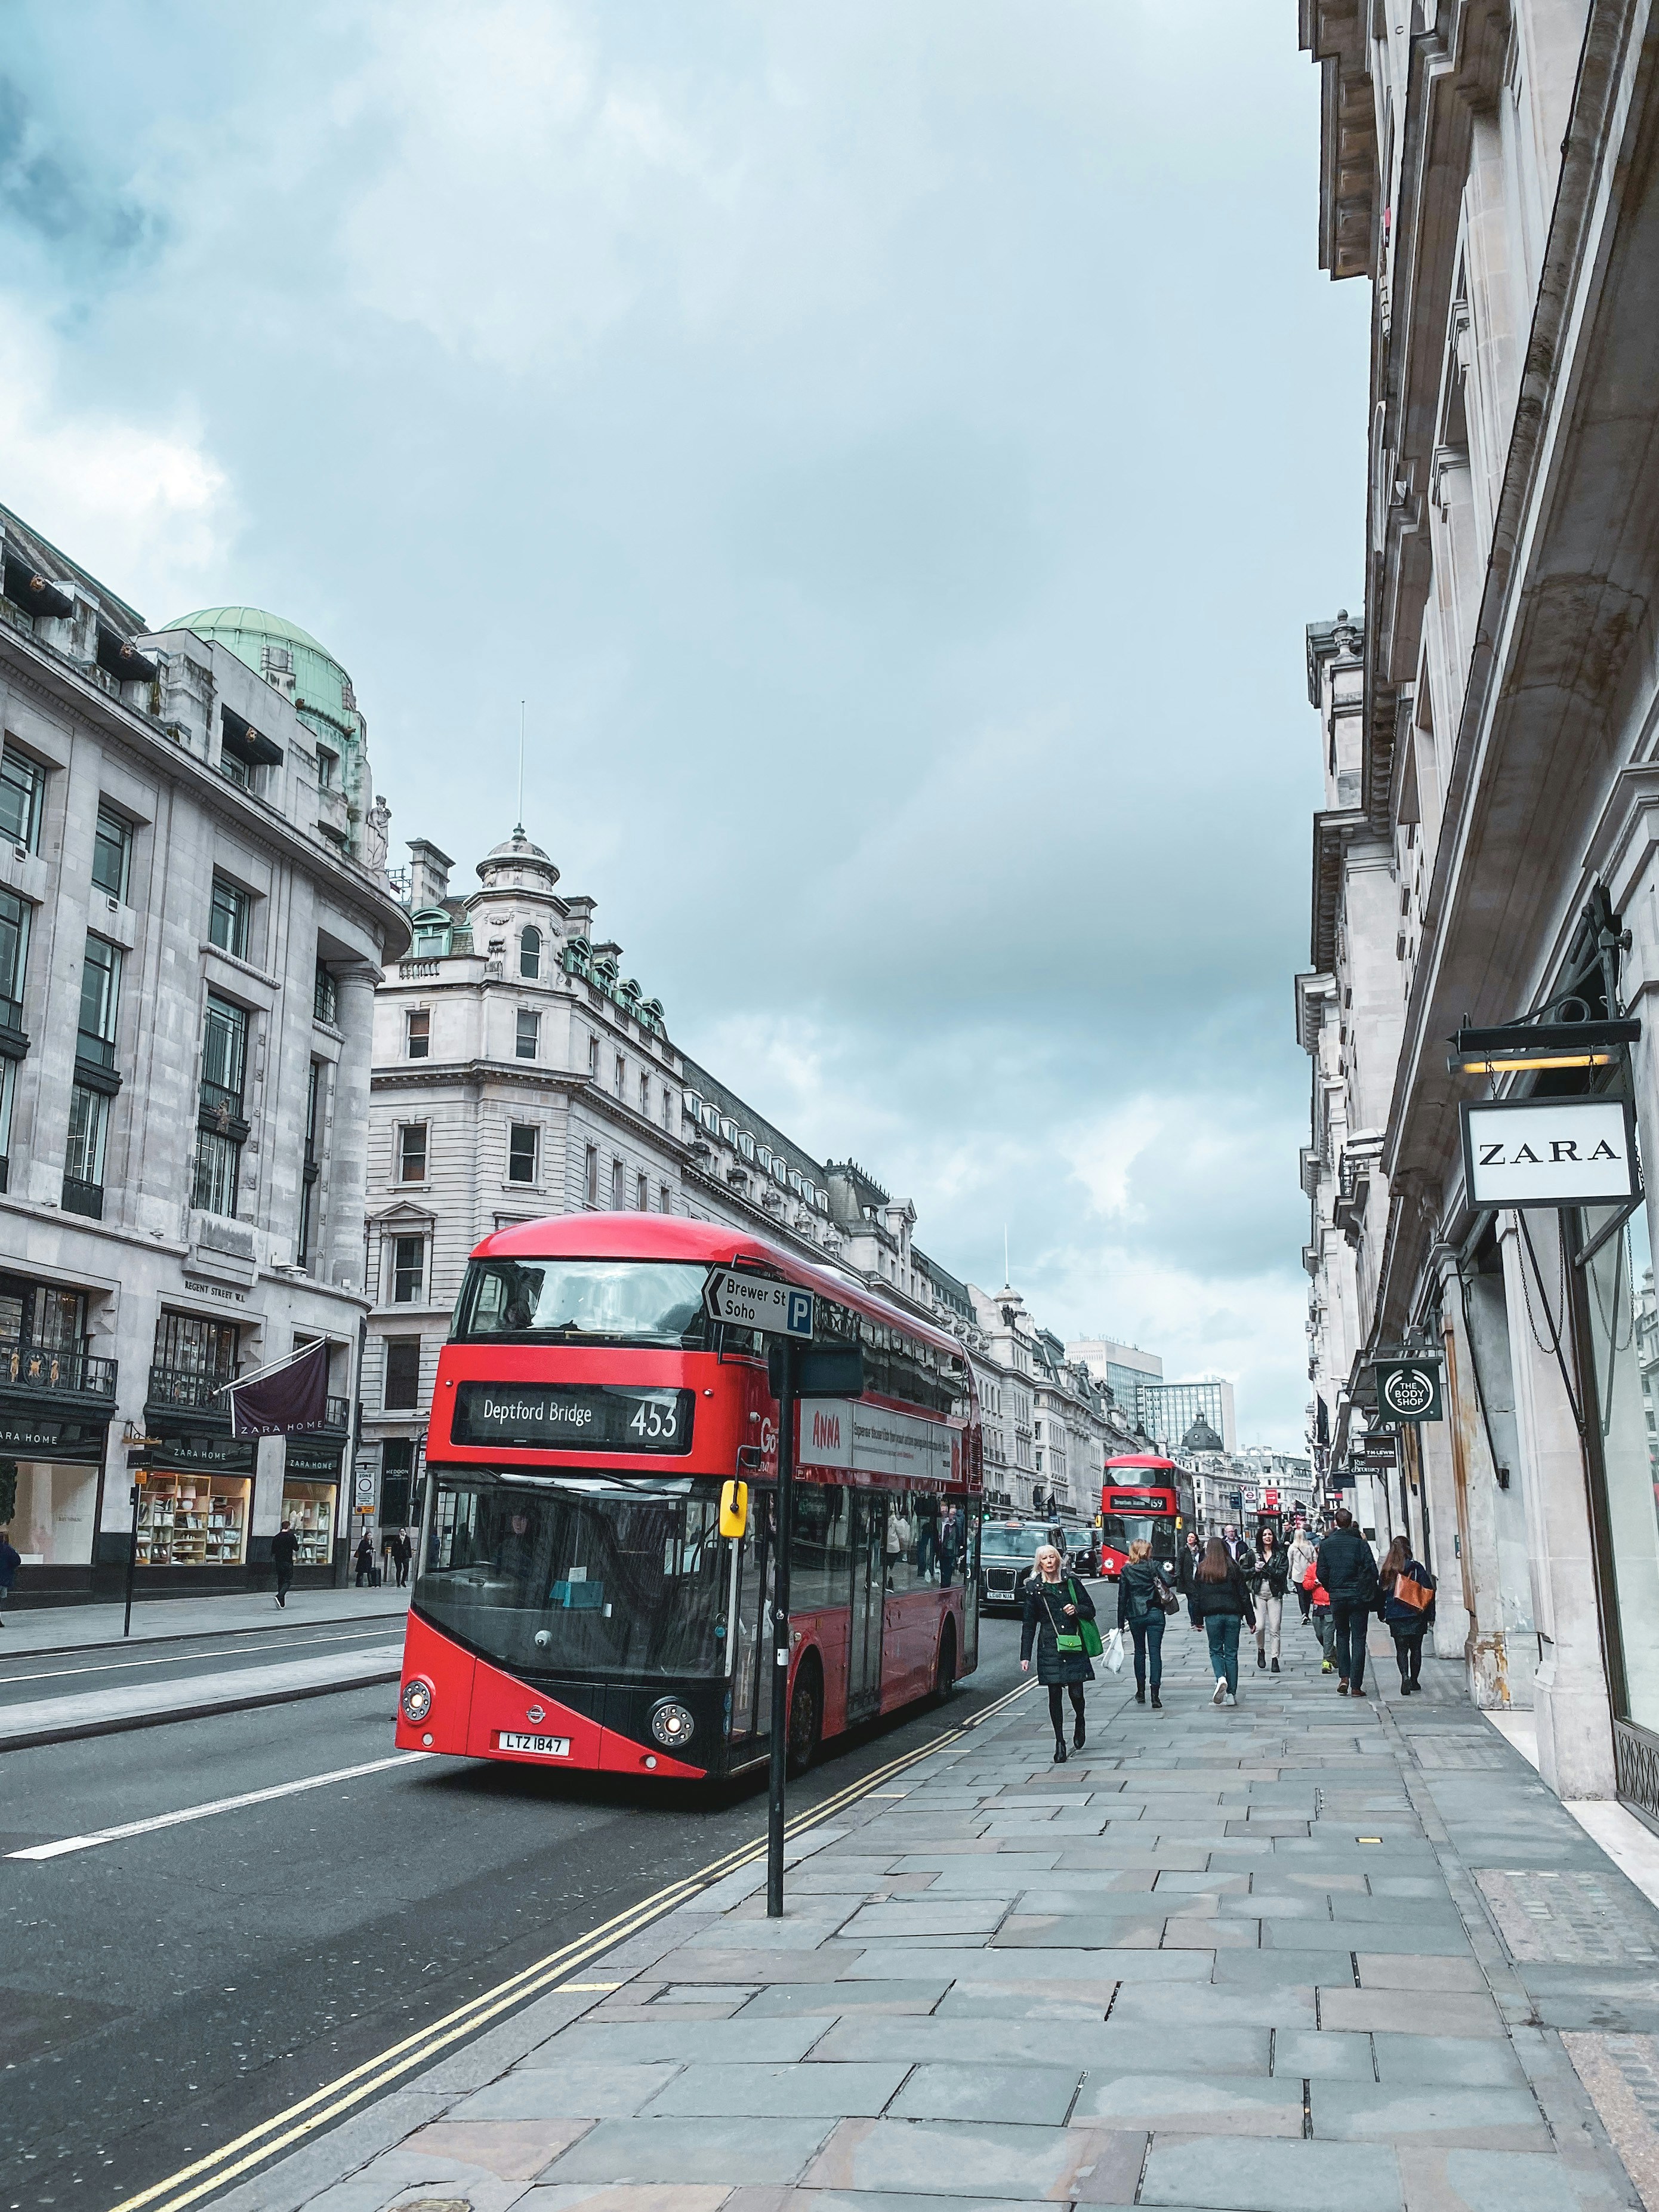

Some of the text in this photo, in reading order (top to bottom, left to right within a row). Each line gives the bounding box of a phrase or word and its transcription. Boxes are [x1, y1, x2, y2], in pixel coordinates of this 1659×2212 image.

[1479, 1139, 1622, 1166] ZARA
[184, 1280, 209, 1294] REGENT
[211, 1287, 233, 1299] STREET
[727, 1278, 786, 1307] Brewer St
[724, 1299, 755, 1320] Soho
[1395, 1390, 1424, 1398] BODY
[483, 1399, 592, 1427] Deptford Bridge
[630, 1401, 677, 1437] 453
[240, 1420, 323, 1434] ZARA HOME
[812, 1410, 840, 1450] ANNA
[25, 1434, 57, 1444] HOME
[174, 1448, 226, 1461] ZARA HOME
[290, 1459, 332, 1470] ZARA HOME
